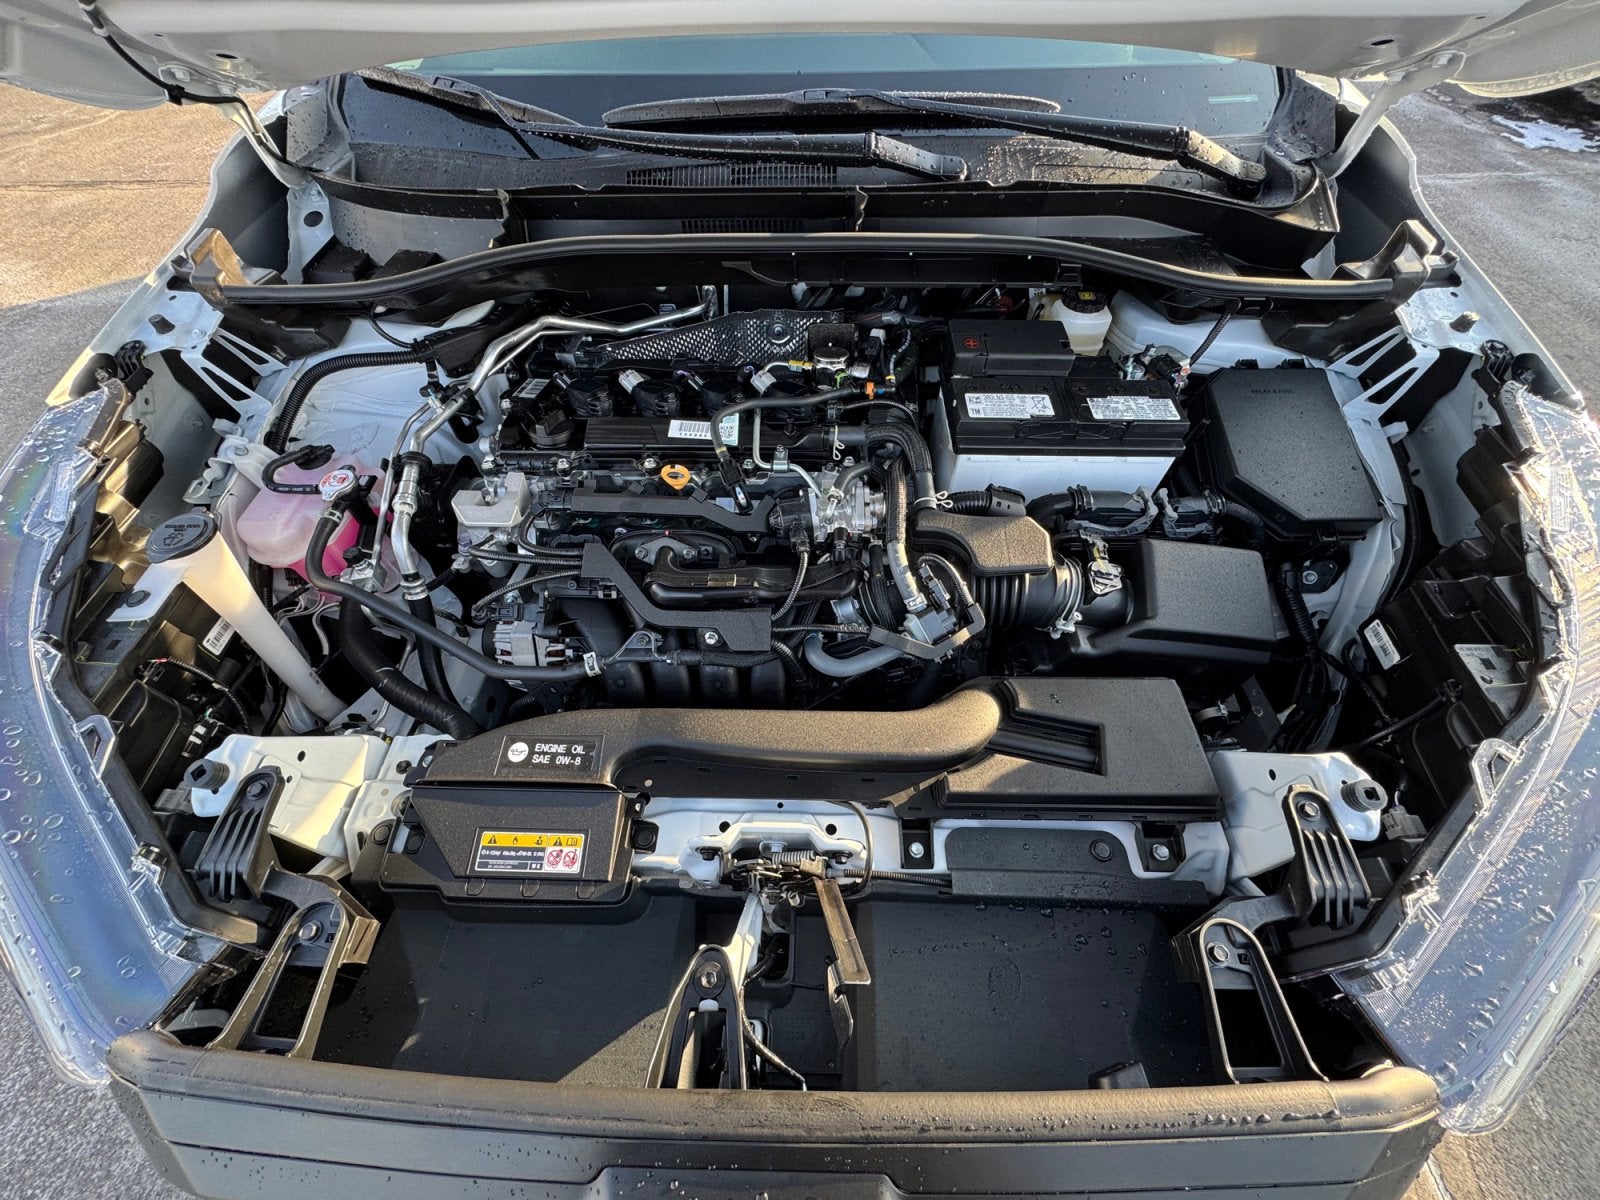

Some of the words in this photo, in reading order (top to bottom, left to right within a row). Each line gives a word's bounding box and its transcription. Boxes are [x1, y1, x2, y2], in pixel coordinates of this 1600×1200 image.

[534, 743, 567, 753] ENGINE
[571, 745, 586, 754] OIL
[531, 754, 552, 764] SAE
[556, 755, 582, 766] 0W-8
